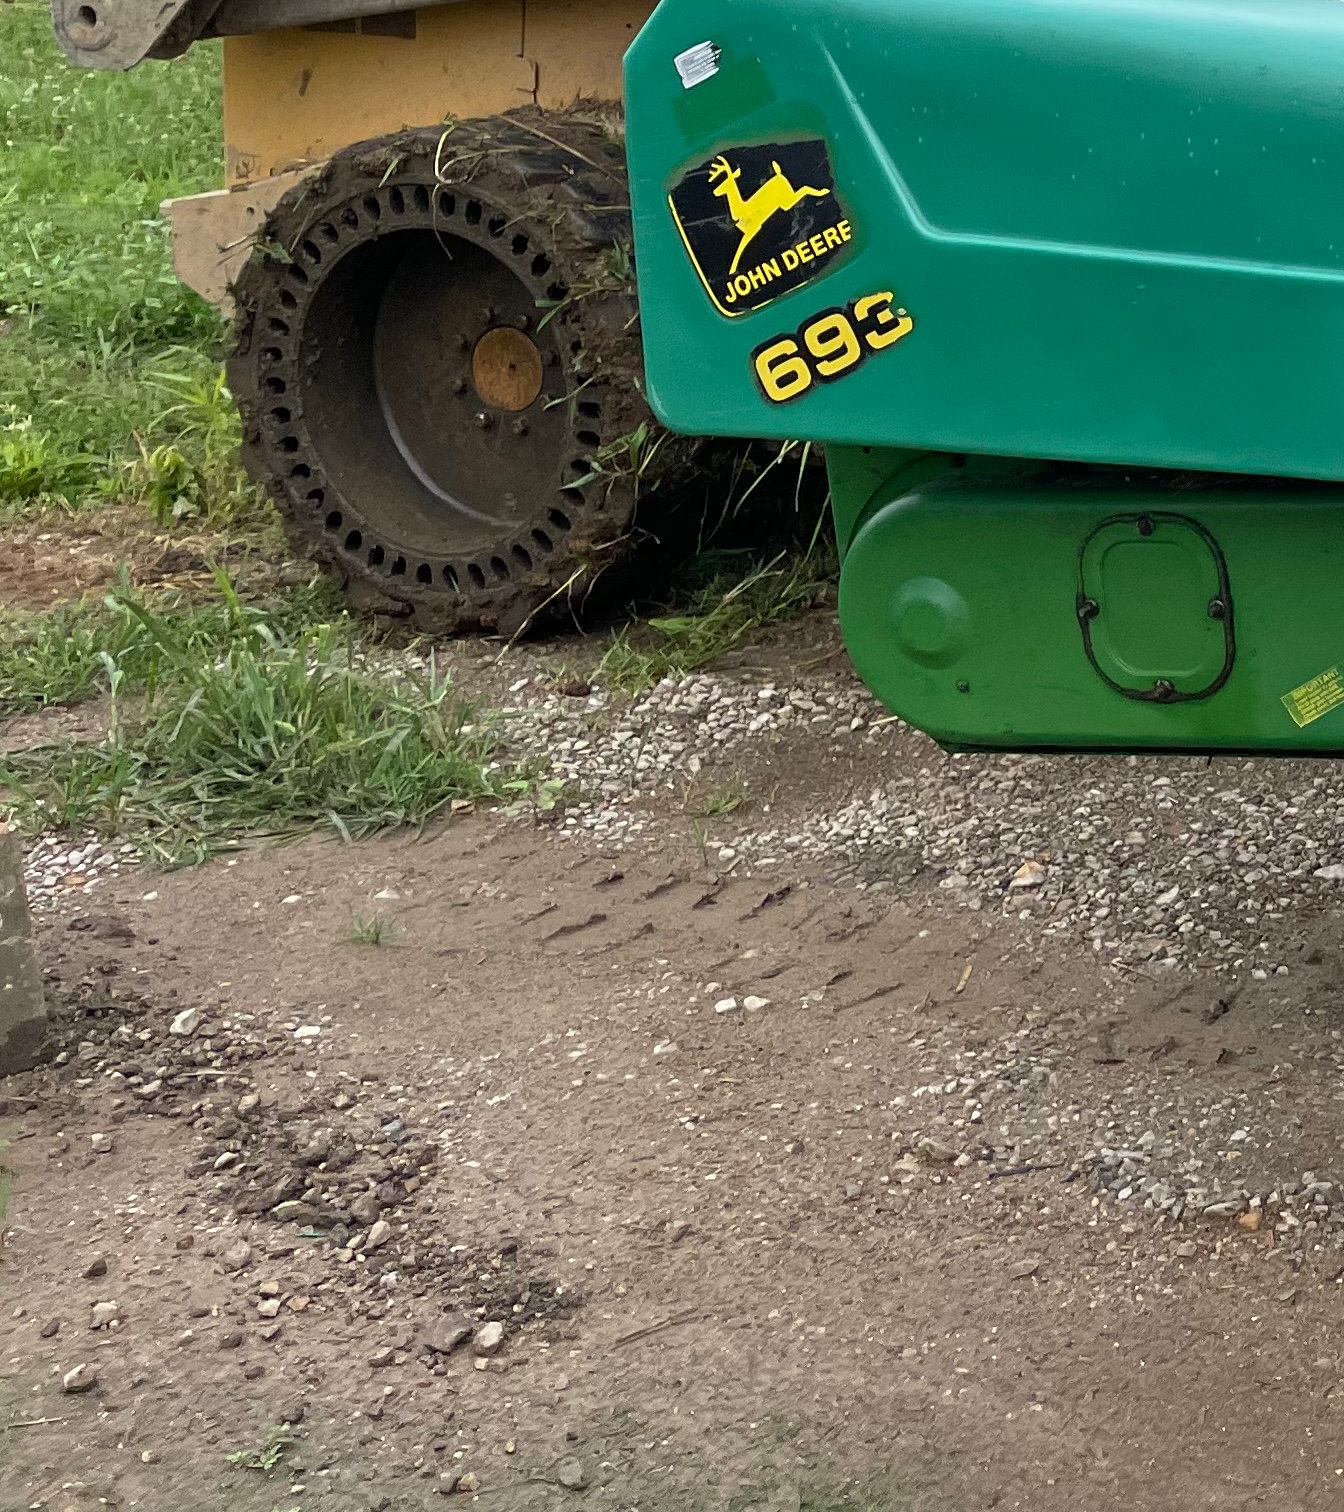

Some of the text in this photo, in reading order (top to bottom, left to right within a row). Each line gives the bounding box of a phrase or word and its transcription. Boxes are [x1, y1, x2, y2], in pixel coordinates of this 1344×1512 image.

[725, 219, 852, 303] JOHN DEERE
[754, 290, 914, 402] 693
[1291, 667, 1339, 700] IMPORTANT
